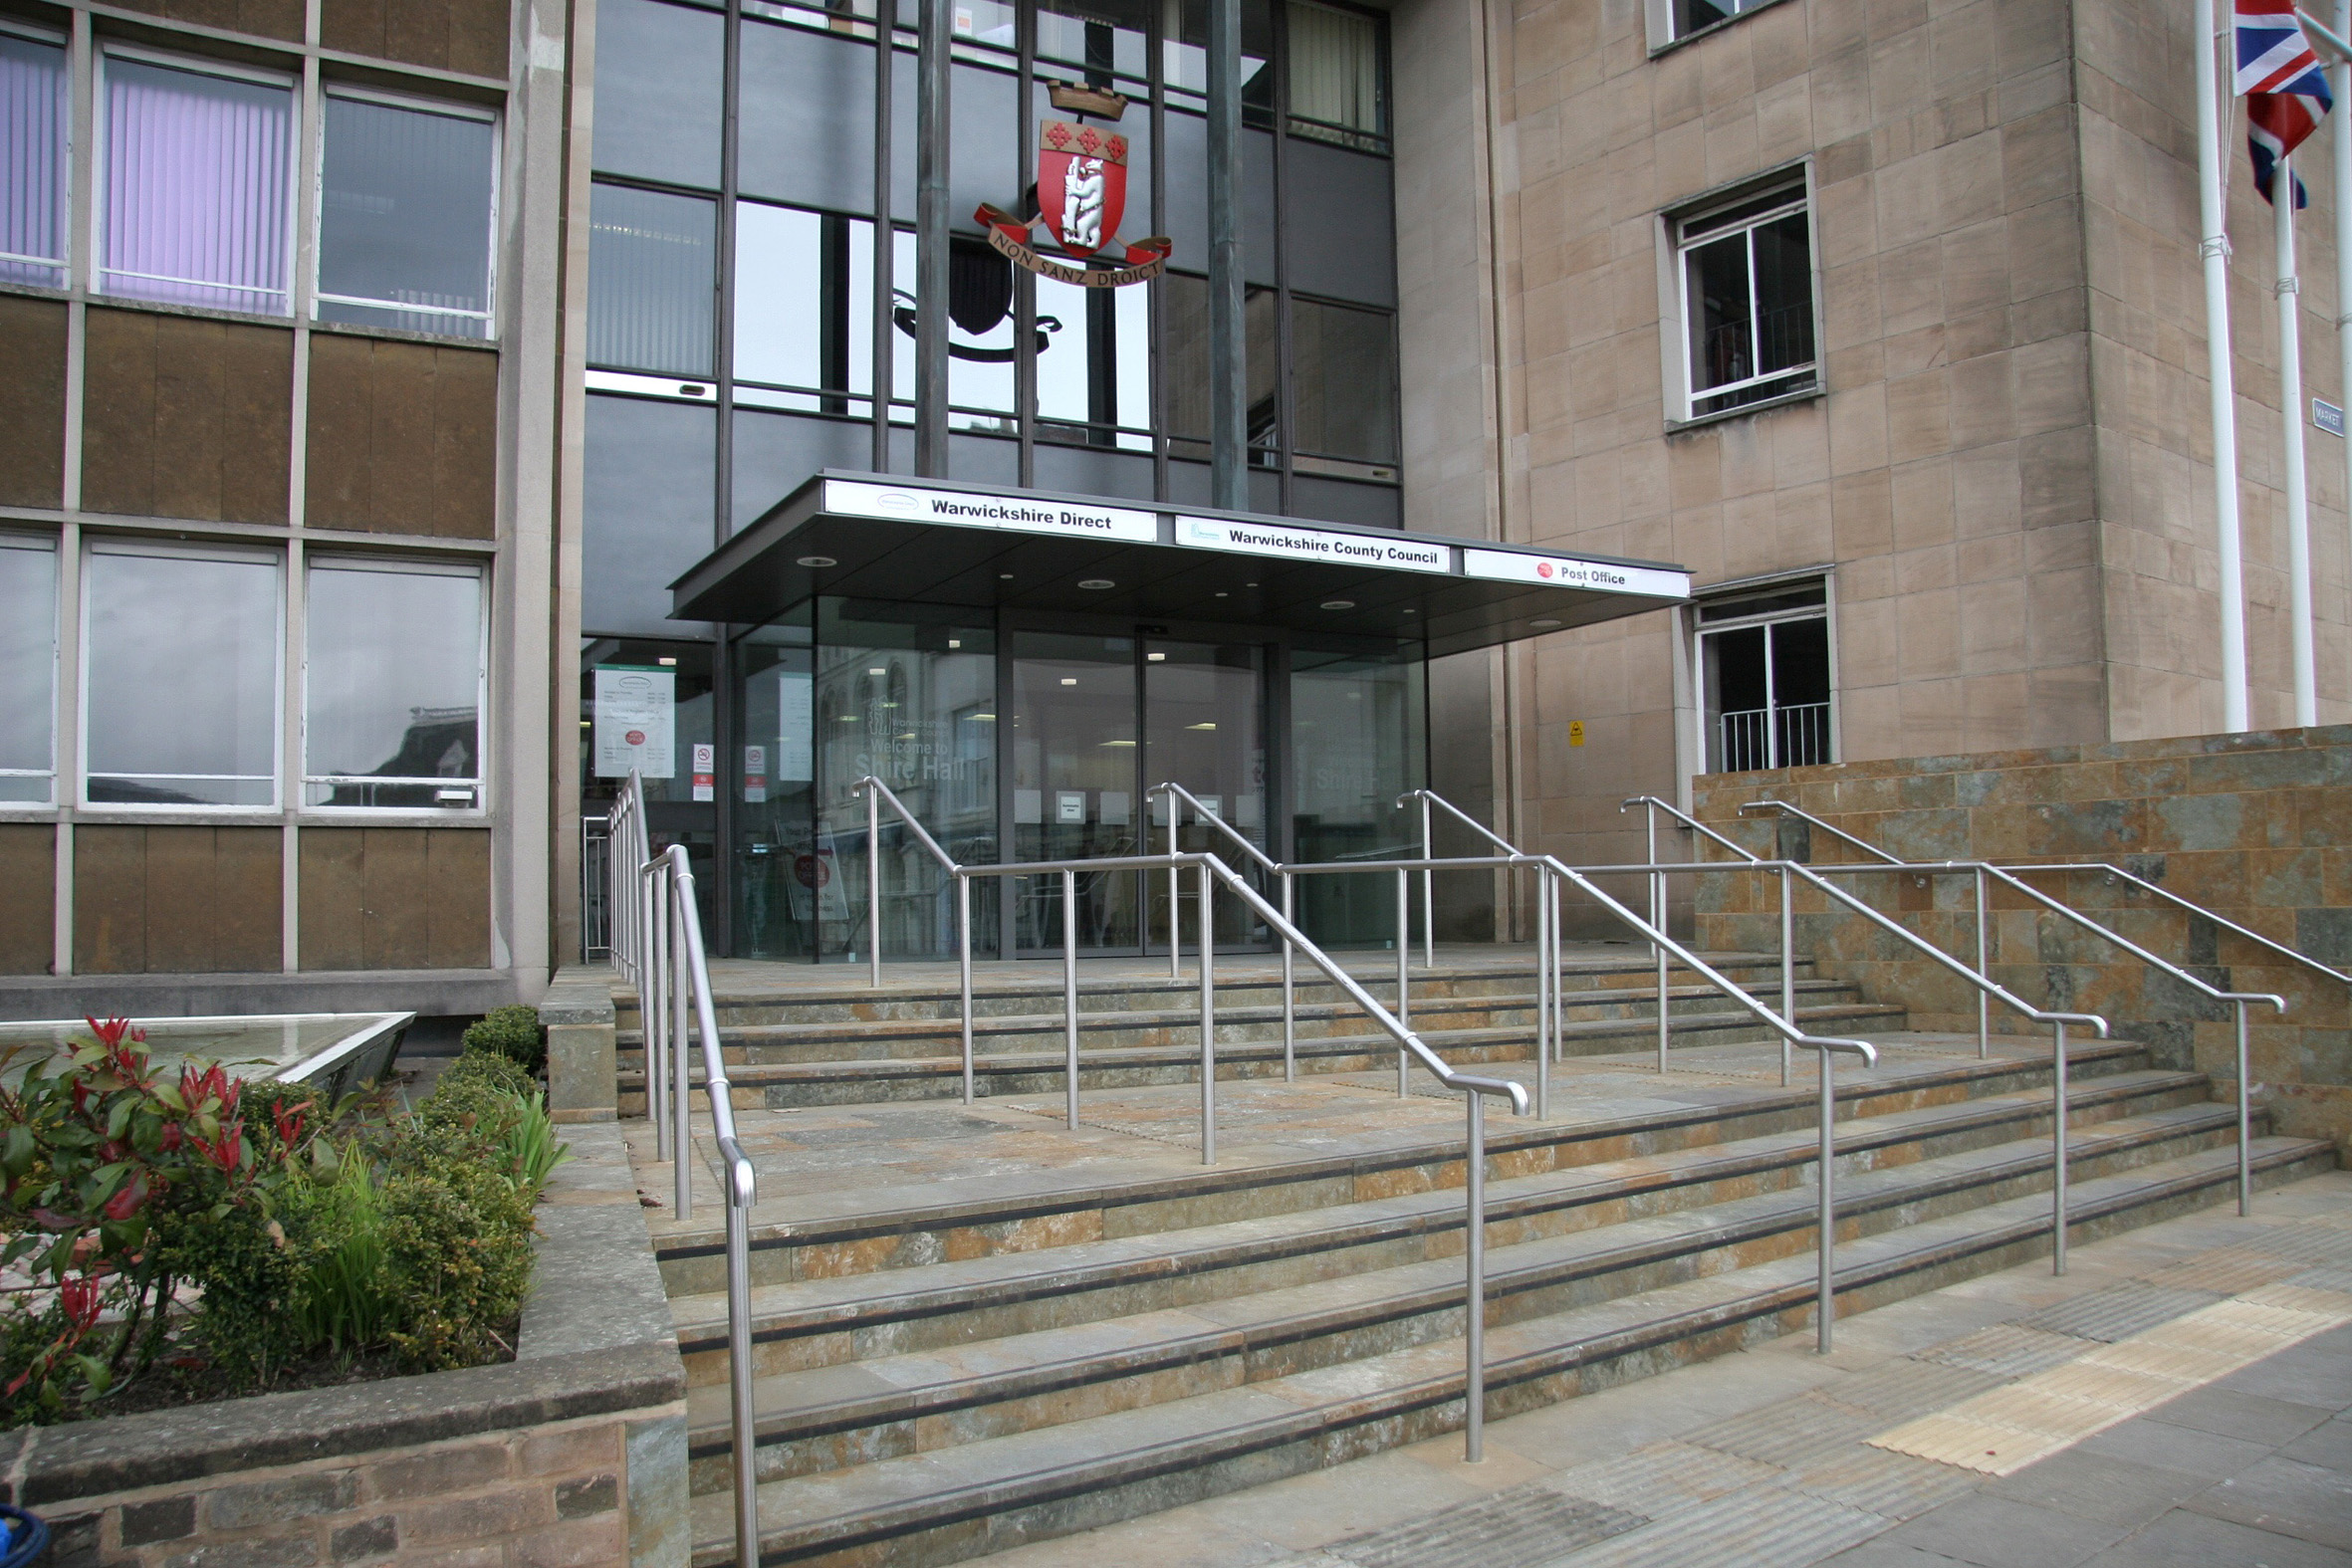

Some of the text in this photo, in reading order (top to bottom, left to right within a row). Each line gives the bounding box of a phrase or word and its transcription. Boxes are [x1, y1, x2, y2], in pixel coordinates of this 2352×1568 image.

[993, 233, 1160, 286] NON SANZ DROICT
[931, 499, 1112, 530] Warwickshire Direct
[1229, 529, 1438, 564] Warwickshire County Council
[1561, 566, 1587, 580] Post
[1591, 570, 1625, 585] Office
[870, 739, 948, 756] Welcome to
[854, 754, 965, 781] Shire Hall
